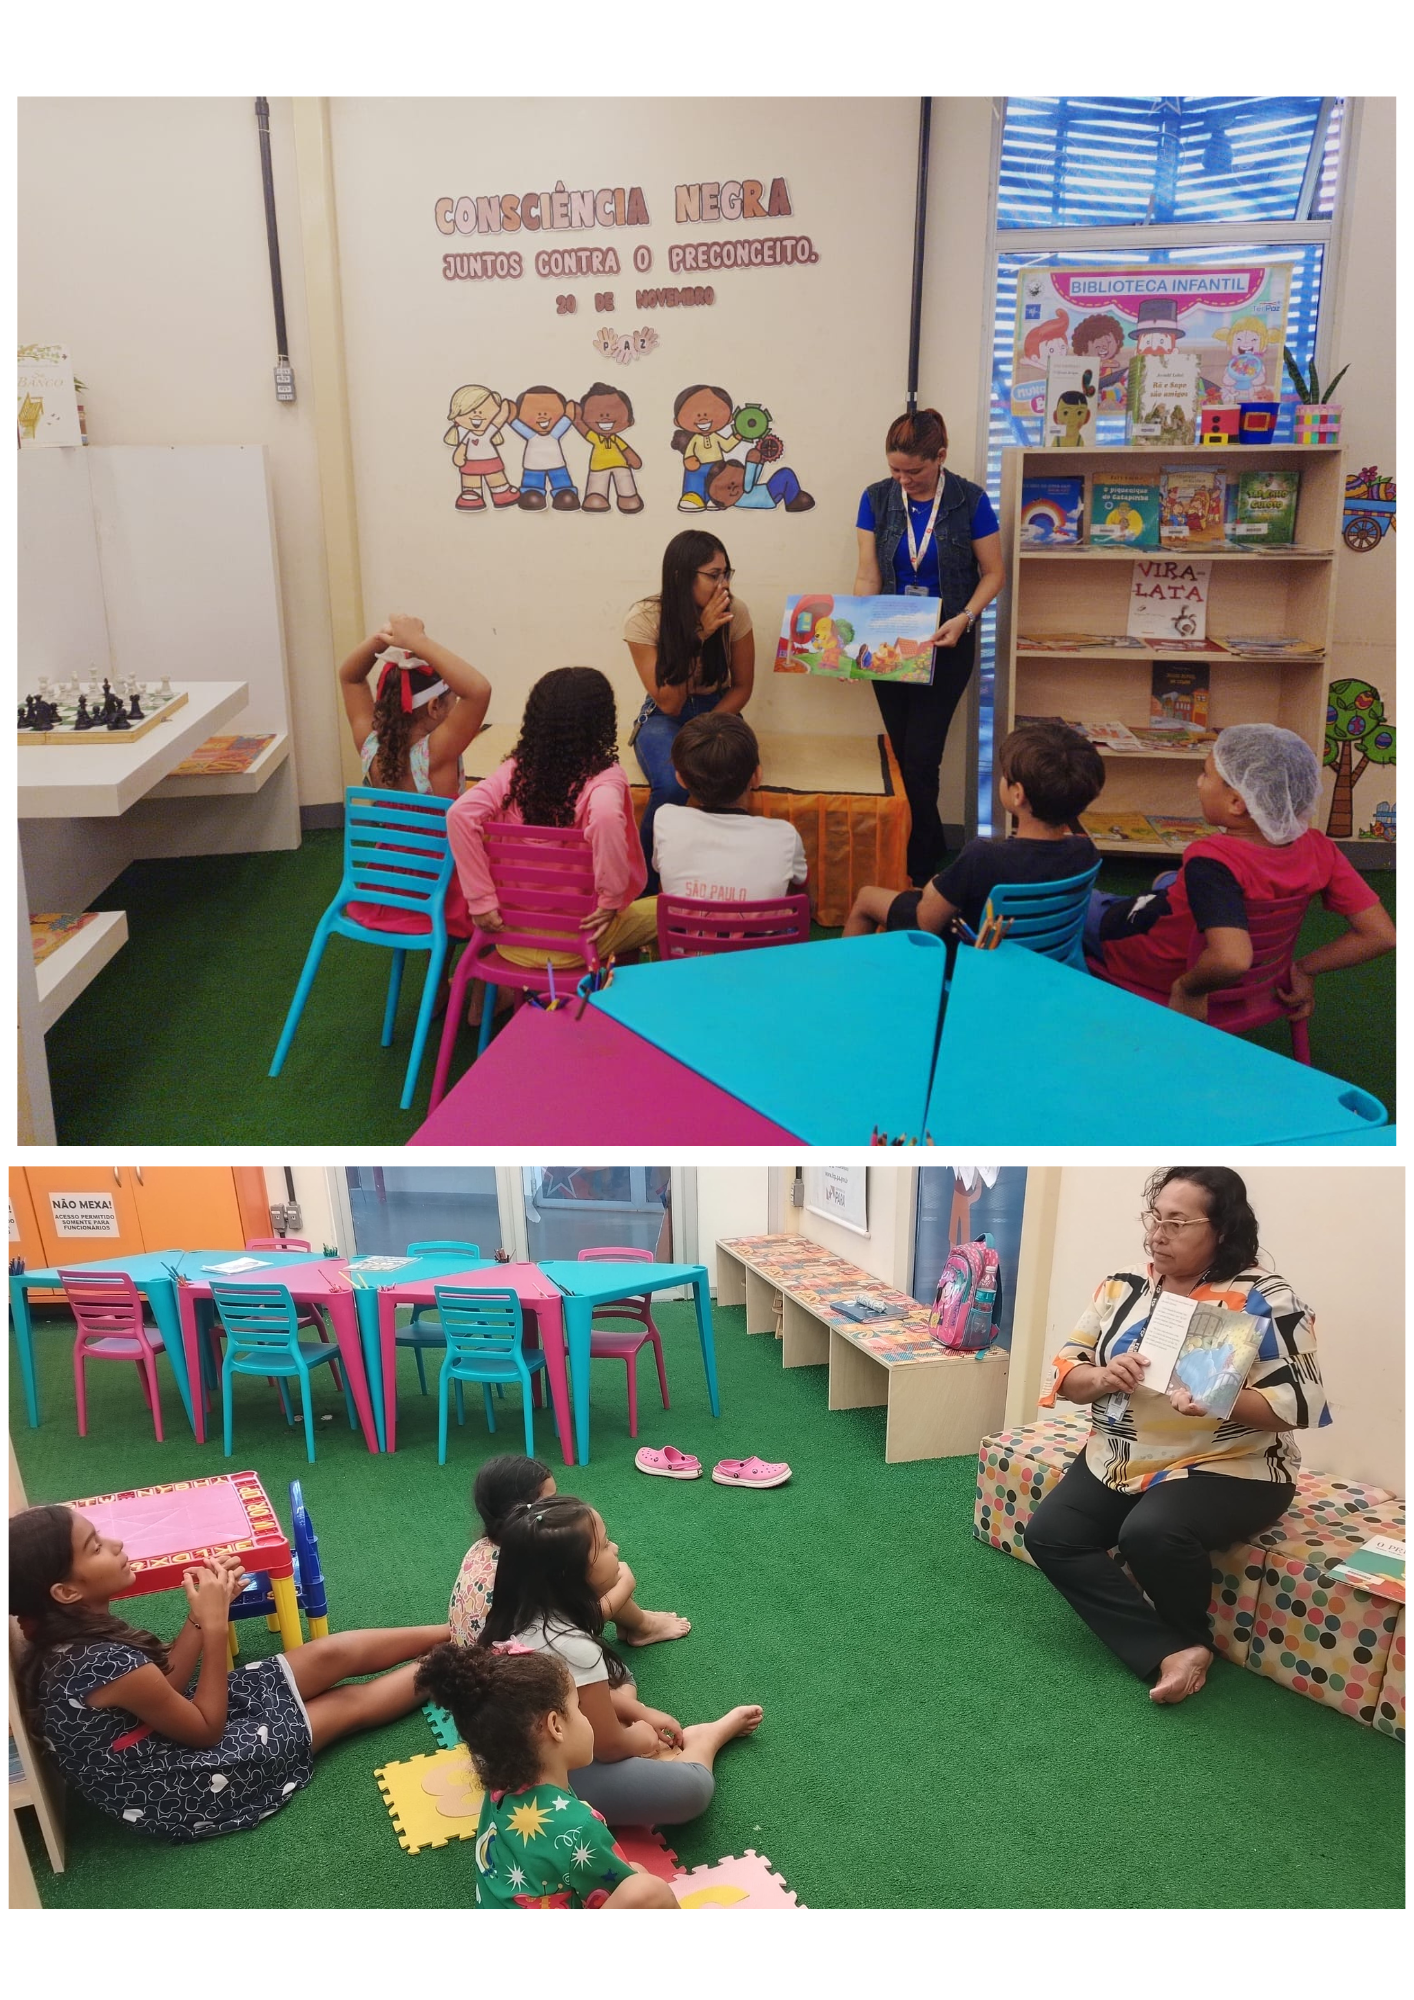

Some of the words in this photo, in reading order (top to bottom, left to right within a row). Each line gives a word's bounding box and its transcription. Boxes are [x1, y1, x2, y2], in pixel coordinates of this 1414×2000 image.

[435, 180, 649, 235] CONSCIÊNCIA
[675, 177, 792, 224] NEGRA
[443, 251, 523, 280] JUNTOS
[536, 247, 620, 277] CONTRA
[634, 245, 652, 273] O
[669, 236, 819, 272] PRECONCEITO.
[1071, 279, 1168, 294] BIBLIOTECA
[1172, 278, 1245, 292] INFANTIL
[556, 294, 576, 314] 20
[595, 291, 615, 312] DE
[636, 286, 714, 309] NOVEMBRO
[1138, 561, 1206, 581] VIRA-
[1133, 583, 1204, 602] LATA
[710, 885, 747, 901] PAULO
[52, 1198, 77, 1209] NÃO
[79, 1200, 112, 1209] MEXA!
